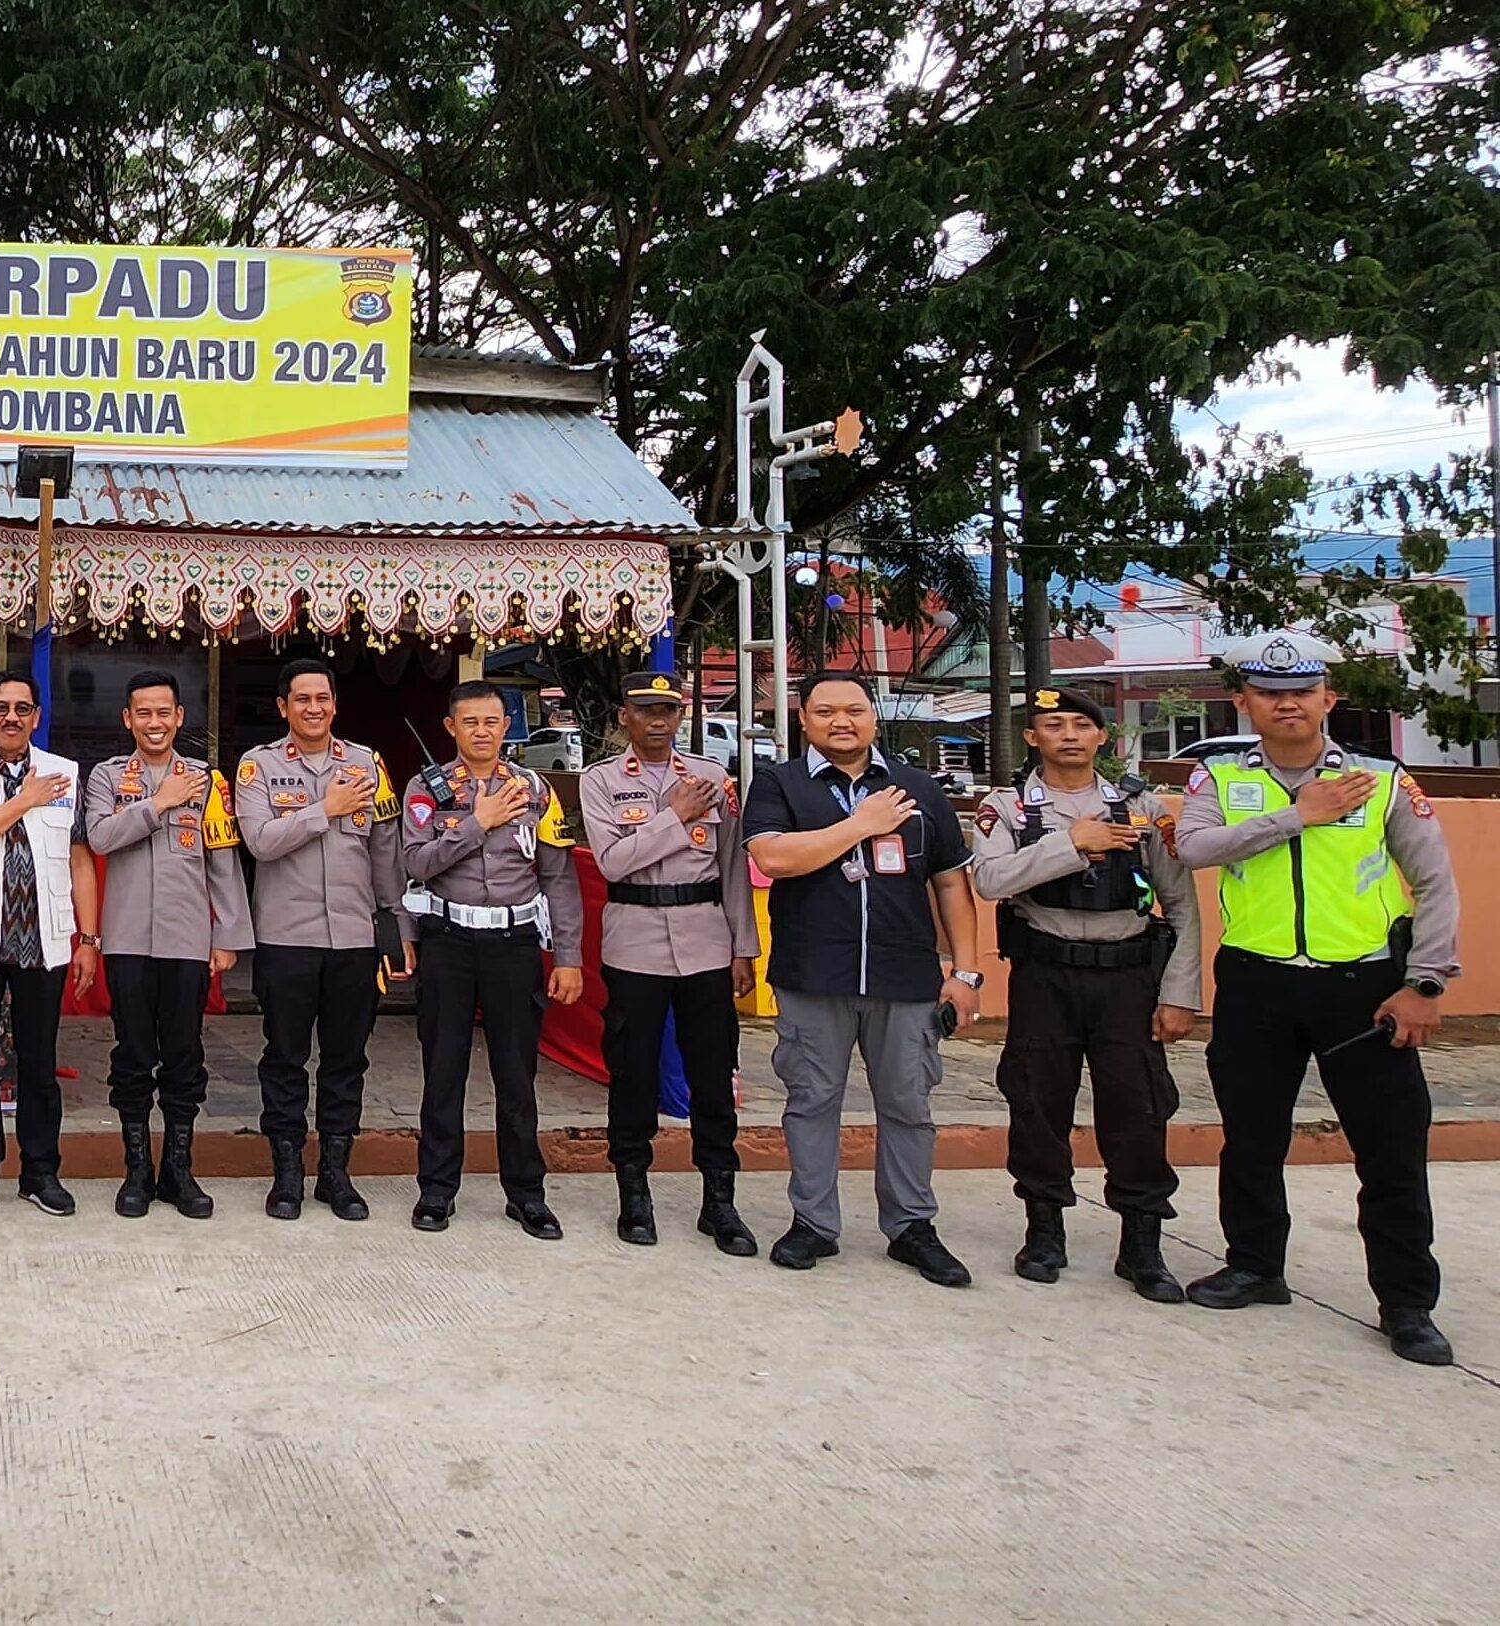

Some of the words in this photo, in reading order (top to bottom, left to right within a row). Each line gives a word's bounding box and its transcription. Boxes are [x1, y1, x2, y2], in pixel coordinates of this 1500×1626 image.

[346, 263, 390, 272] BOMBANA
[137, 338, 255, 381] BARU
[274, 341, 386, 383] 2024
[270, 777, 305, 786] REDA
[612, 791, 648, 802] WIDODO
[204, 821, 221, 843] KA
[223, 820, 238, 839] OP
